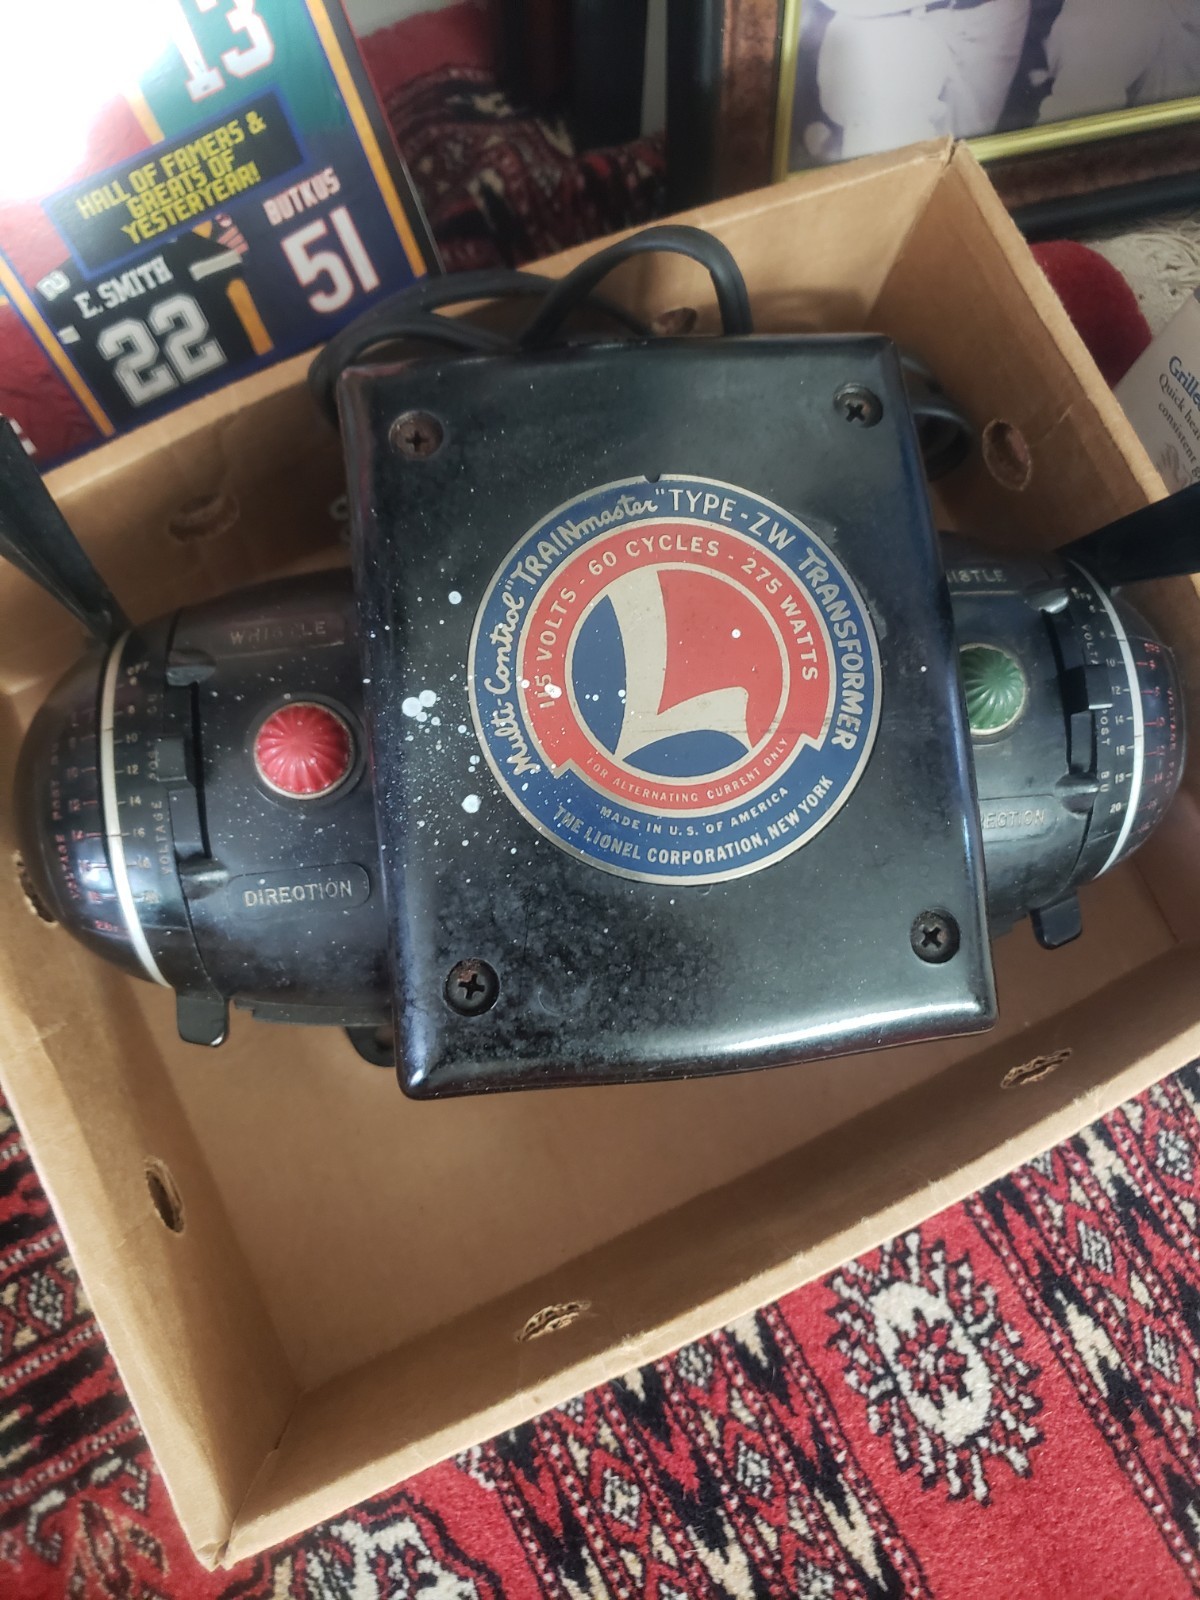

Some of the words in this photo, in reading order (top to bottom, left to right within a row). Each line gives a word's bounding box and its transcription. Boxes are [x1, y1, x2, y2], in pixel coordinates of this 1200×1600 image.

[75, 180, 131, 219] HALL
[128, 162, 158, 193] OF
[159, 119, 246, 177] FAMERS
[245, 110, 267, 135] &
[126, 164, 208, 220] GREATS
[207, 148, 236, 178] OF
[262, 166, 342, 226] BUTKUS
[120, 160, 261, 244] YESTERYEAR!
[279, 204, 381, 314] 51
[96, 293, 229, 407] 22
[1159, 372, 1186, 413] Quick
[1168, 355, 1200, 412] Grille
[1158, 401, 1197, 464] consistent
[536, 587, 577, 662] VOLTS
[588, 551, 617, 576] 60
[625, 534, 721, 558] CYCLES
[740, 557, 783, 595] 275
[779, 594, 819, 681] WATTS
[798, 546, 866, 750] TRANSFORMER
[1105, 658, 1117, 668] 10
[1110, 685, 1122, 696] 12
[1114, 714, 1125, 726] 14
[127, 763, 140, 776] 12
[586, 757, 609, 779] FOR
[612, 777, 699, 803] ALTERNATING
[706, 767, 761, 800] CURRENT
[763, 737, 788, 767] ONLY
[1115, 744, 1126, 756] 16
[150, 800, 174, 876] VOLTAGE
[553, 805, 585, 834] THE
[583, 825, 641, 860] LIONEL
[646, 832, 770, 866] CORPORATION,
[766, 809, 800, 840] NEW
[797, 775, 834, 815] YORK
[599, 806, 640, 830] MADE
[646, 823, 662, 834] IN
[705, 820, 724, 833] OF
[729, 786, 789, 828] AMERICA
[1109, 801, 1123, 814] 20
